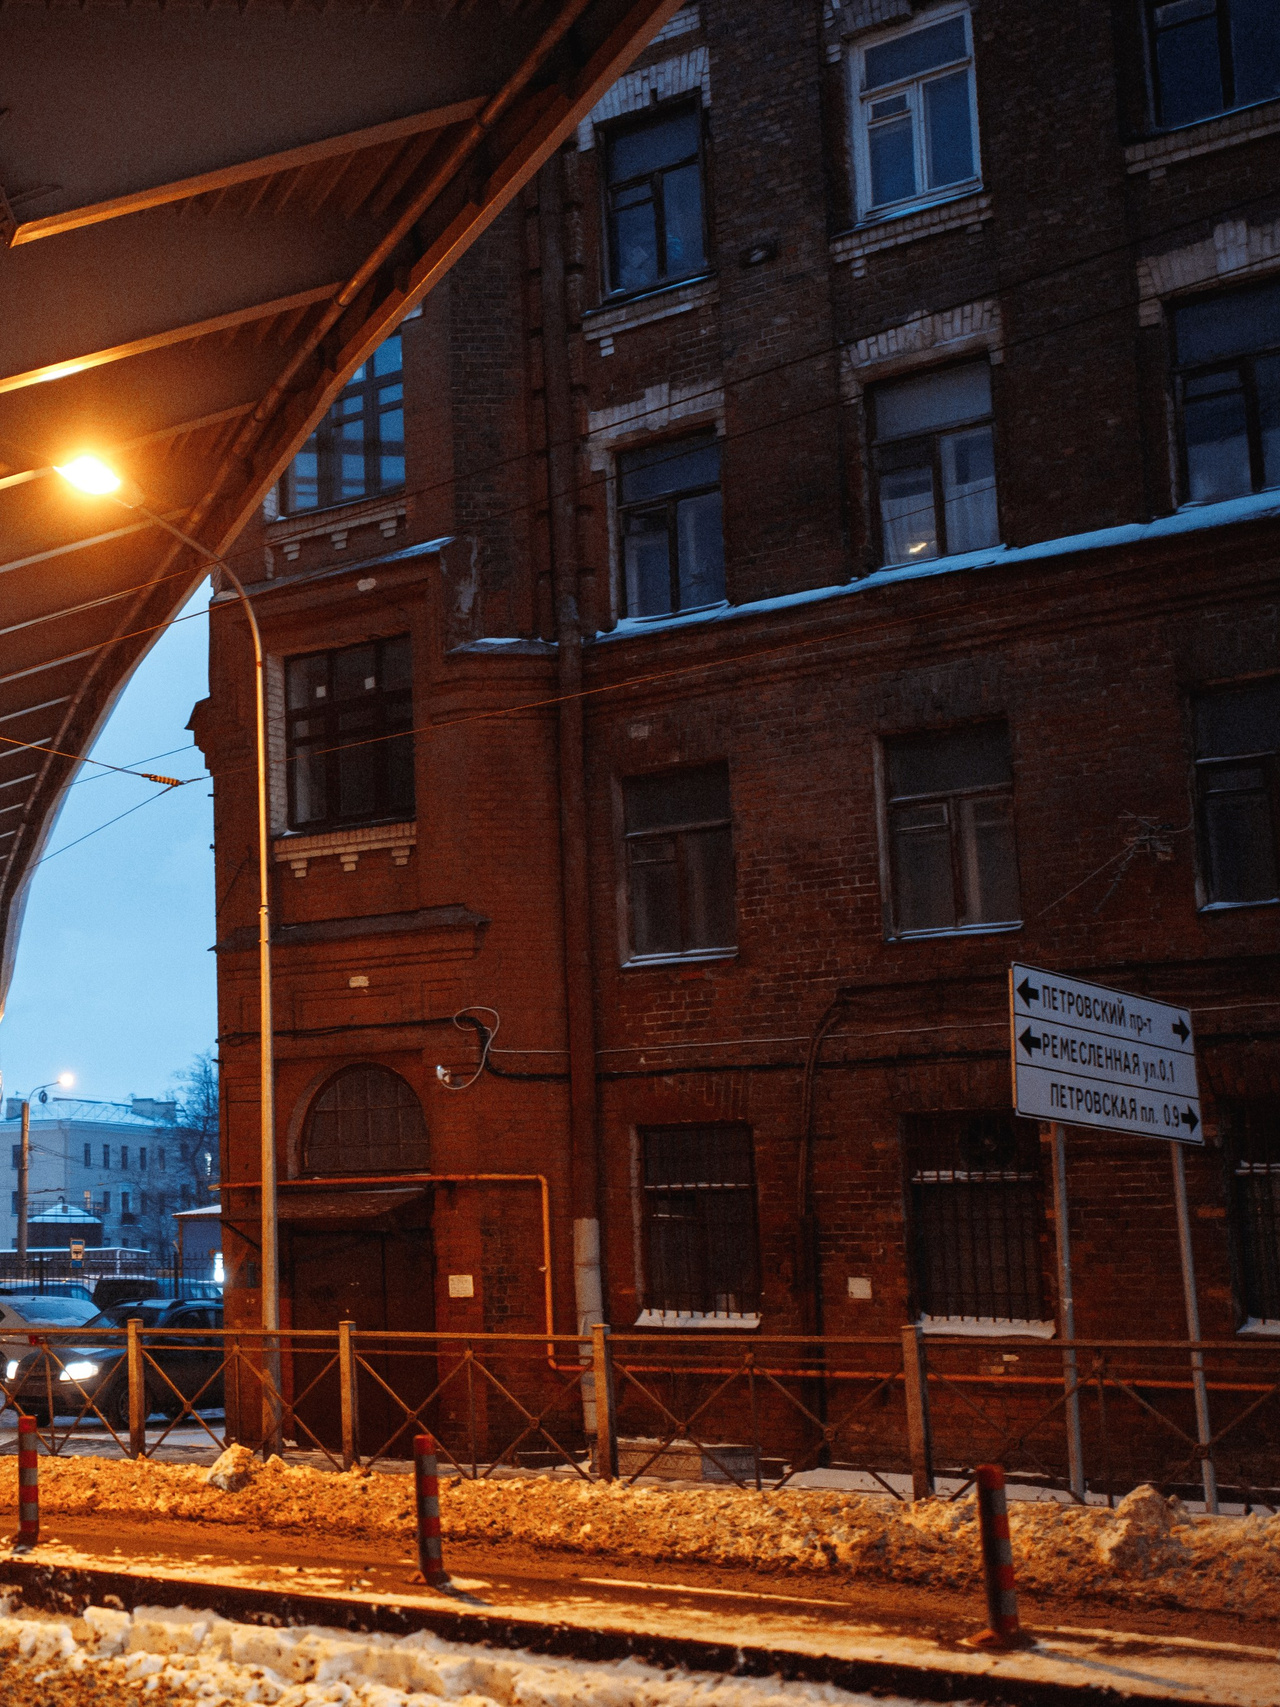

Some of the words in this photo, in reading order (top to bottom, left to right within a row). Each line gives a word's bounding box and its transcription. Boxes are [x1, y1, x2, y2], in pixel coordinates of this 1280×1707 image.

[1042, 985, 1126, 1027] ПЕТРОВСКИЙ
[1130, 1014, 1152, 1037] пр-т
[1042, 1033, 1140, 1076] РЕМЕСЛЕННАЯ
[1050, 1083, 1137, 1121] ПЕТРОВСКАЯ
[1141, 1106, 1158, 1124] пл.
[1163, 1104, 1180, 1127] 0.9
